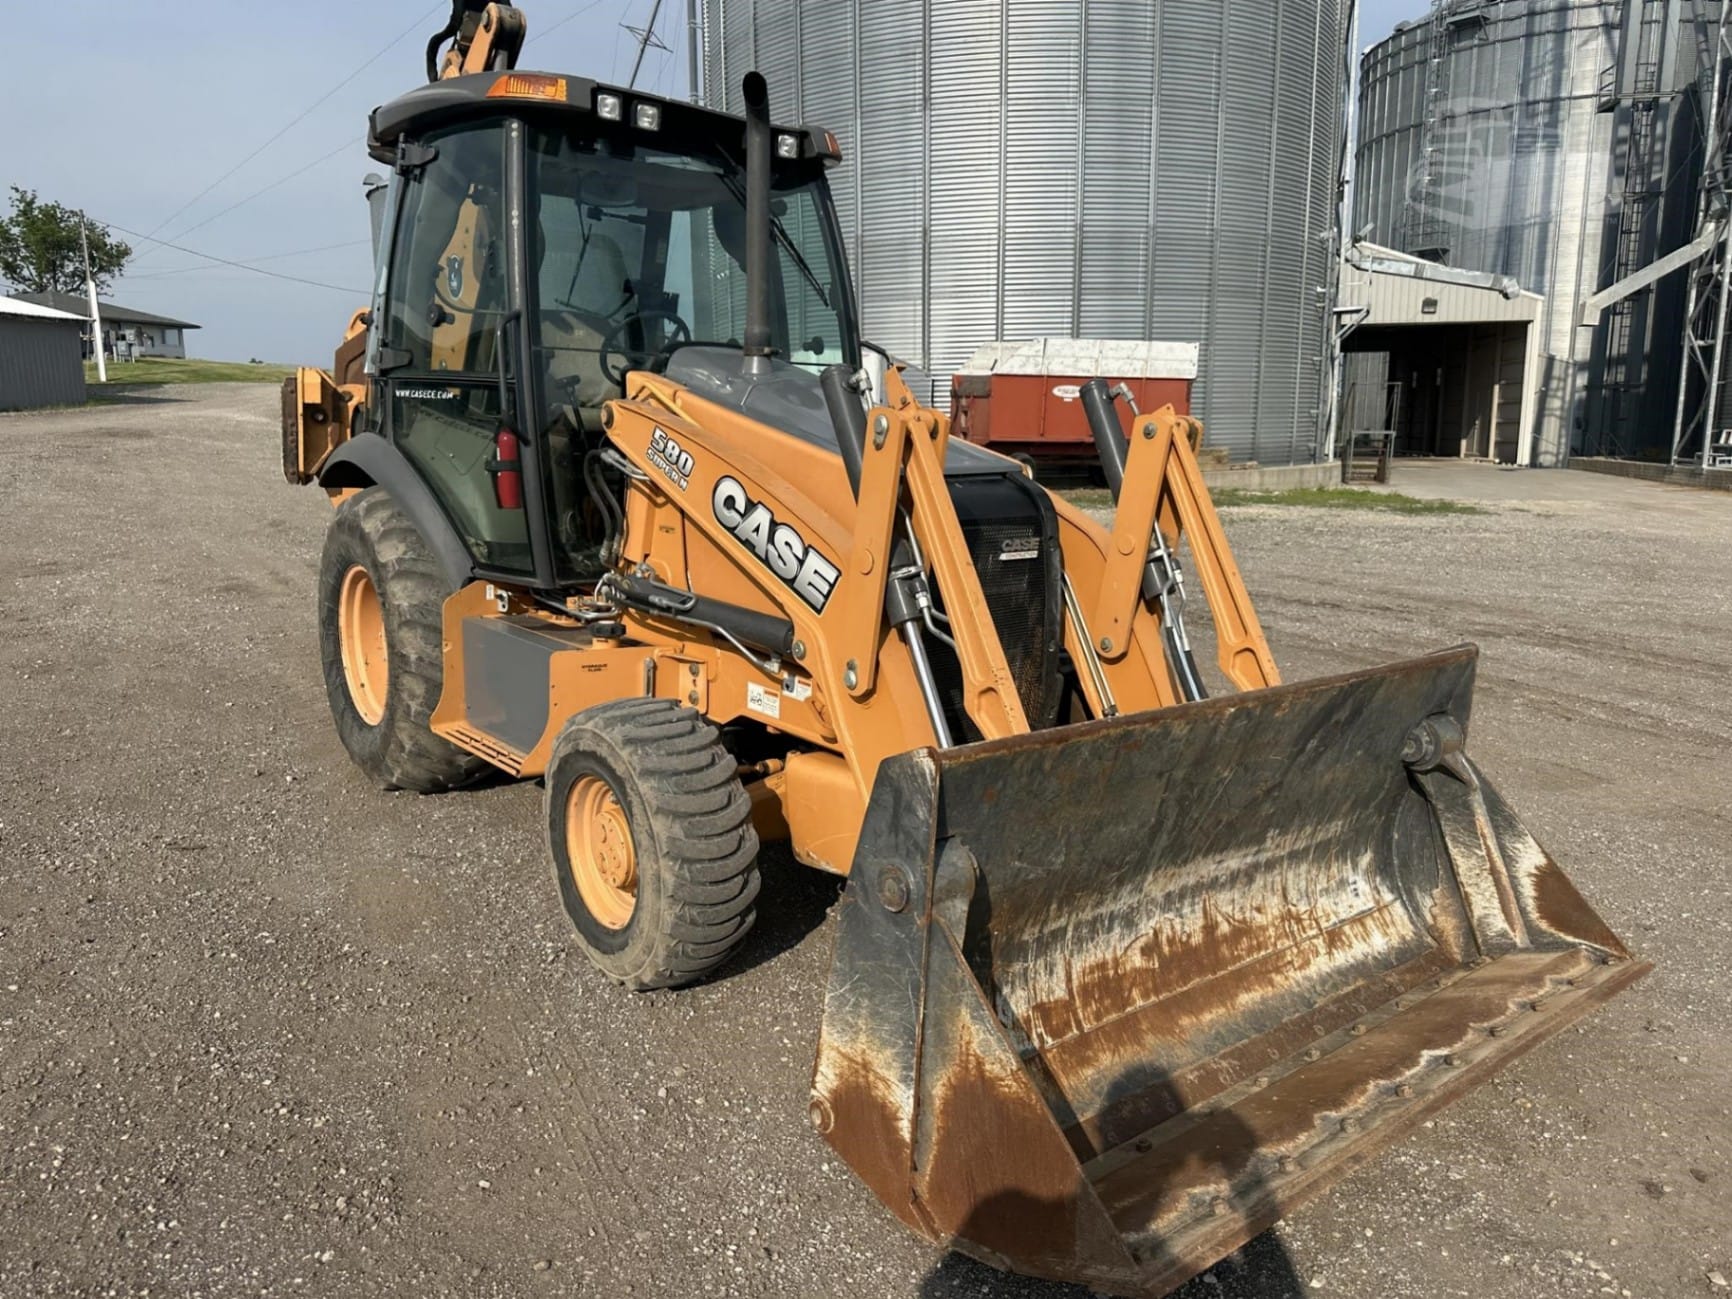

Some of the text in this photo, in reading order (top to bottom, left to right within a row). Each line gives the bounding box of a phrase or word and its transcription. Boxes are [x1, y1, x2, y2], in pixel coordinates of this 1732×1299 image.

[647, 447, 680, 483] SUPER
[652, 426, 695, 477] 580
[713, 476, 841, 614] CASE
[1002, 537, 1040, 551] CASE
